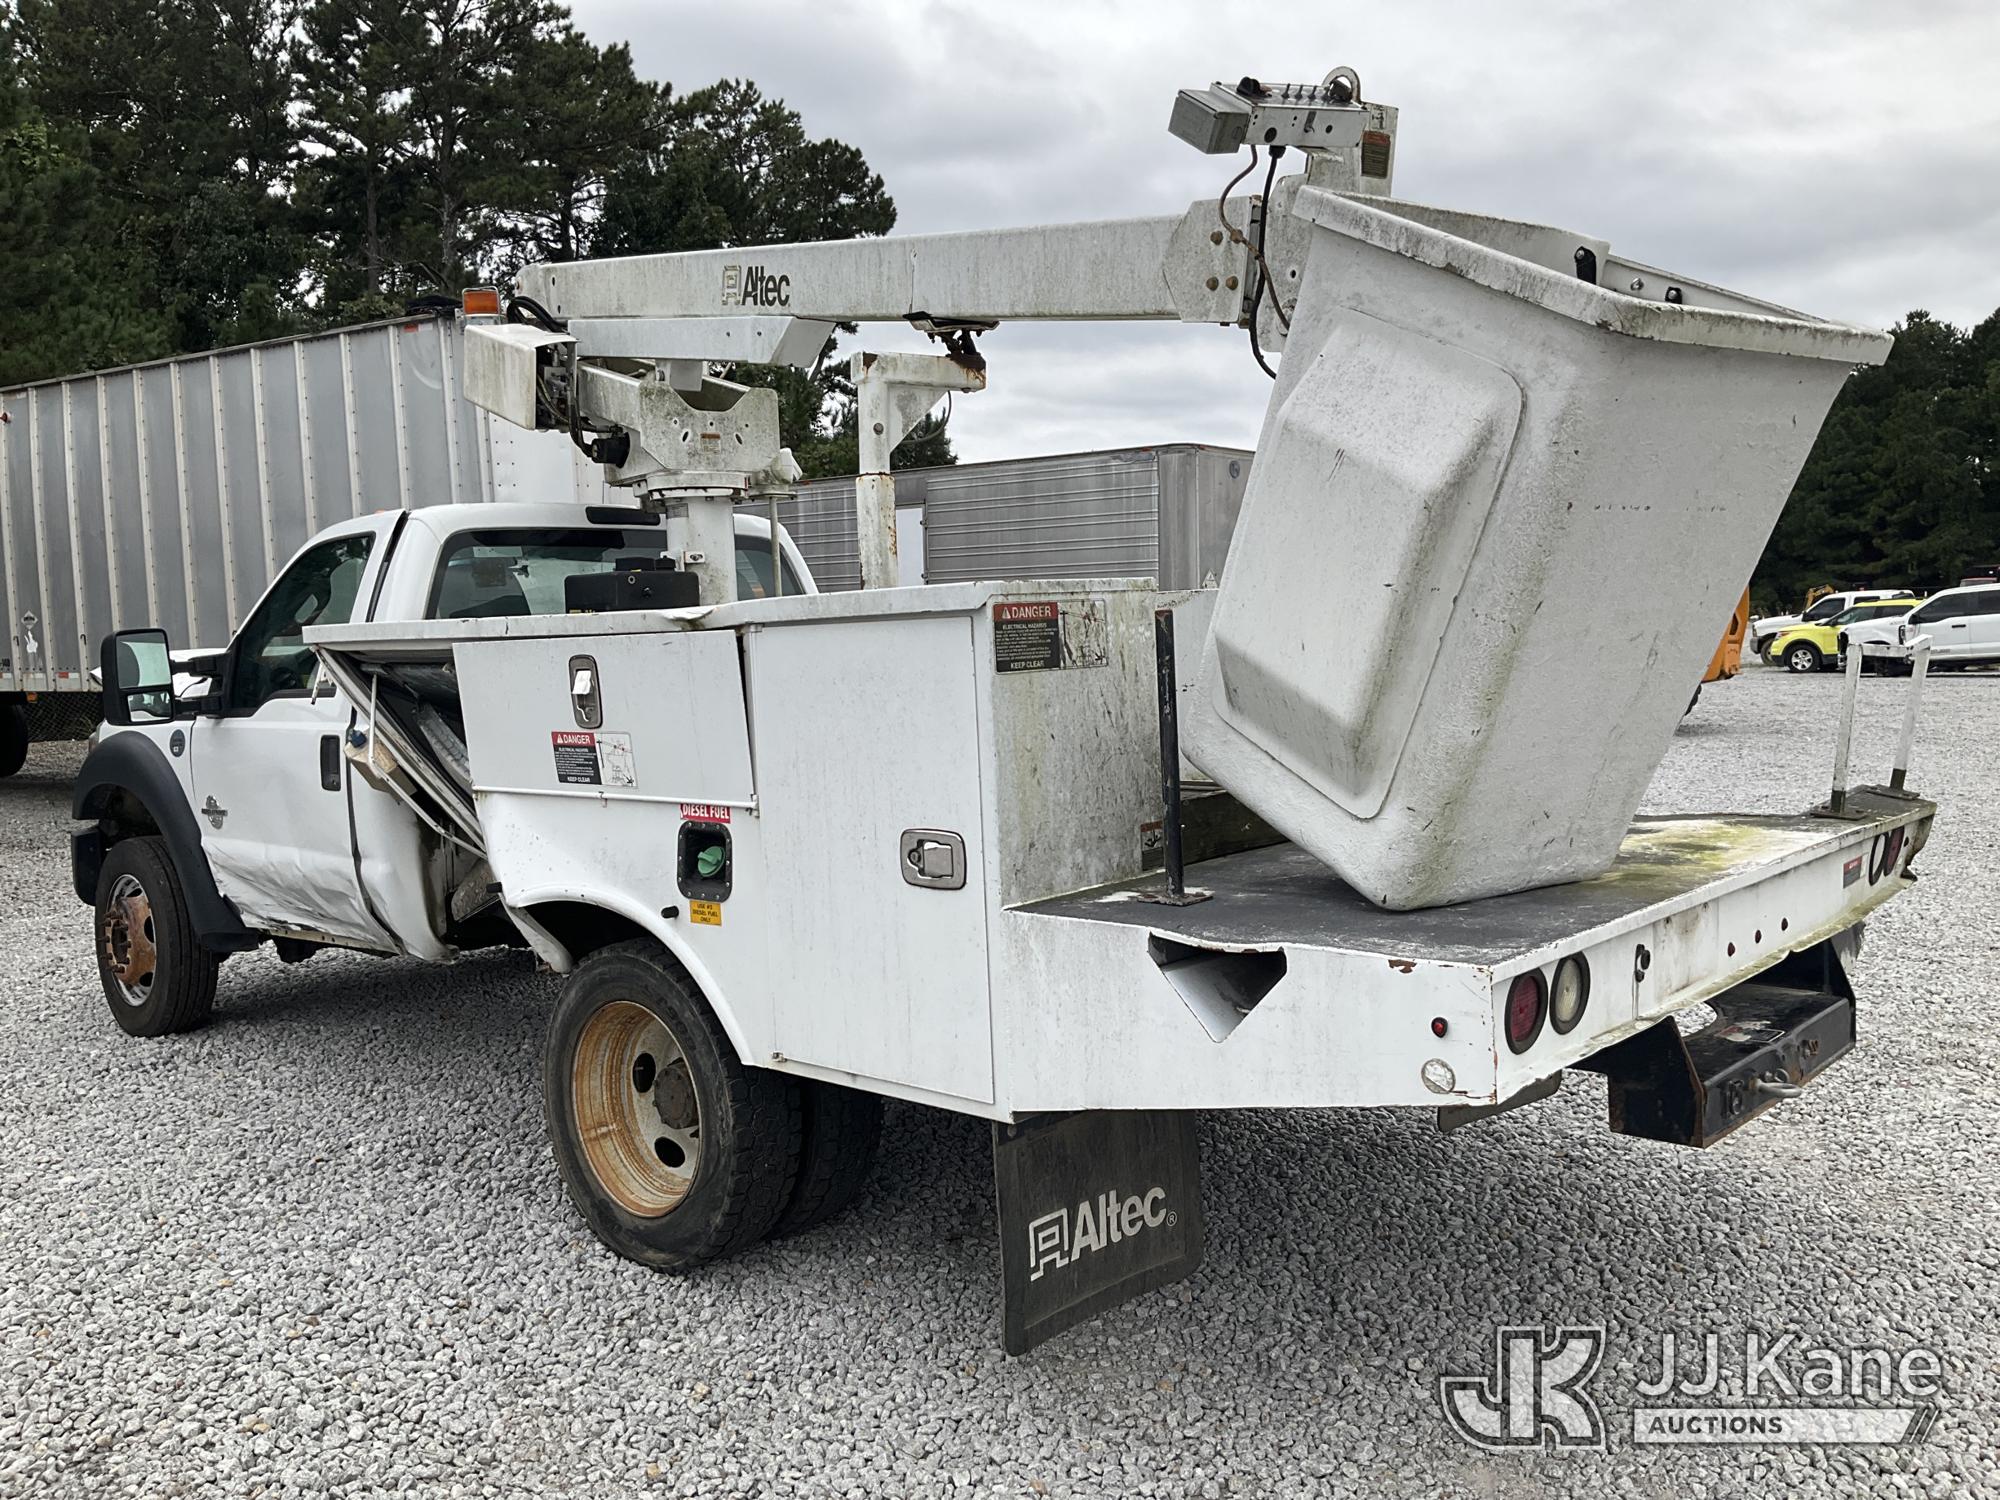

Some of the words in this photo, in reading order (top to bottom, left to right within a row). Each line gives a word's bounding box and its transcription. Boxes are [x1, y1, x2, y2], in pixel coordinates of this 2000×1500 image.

[741, 265, 790, 307] Altec
[1011, 605, 1052, 619] DANGER
[1010, 661, 1026, 669] KEEP
[563, 734, 591, 744] DANGER
[682, 804, 709, 817] DIESEL
[710, 805, 730, 820] FUEL
